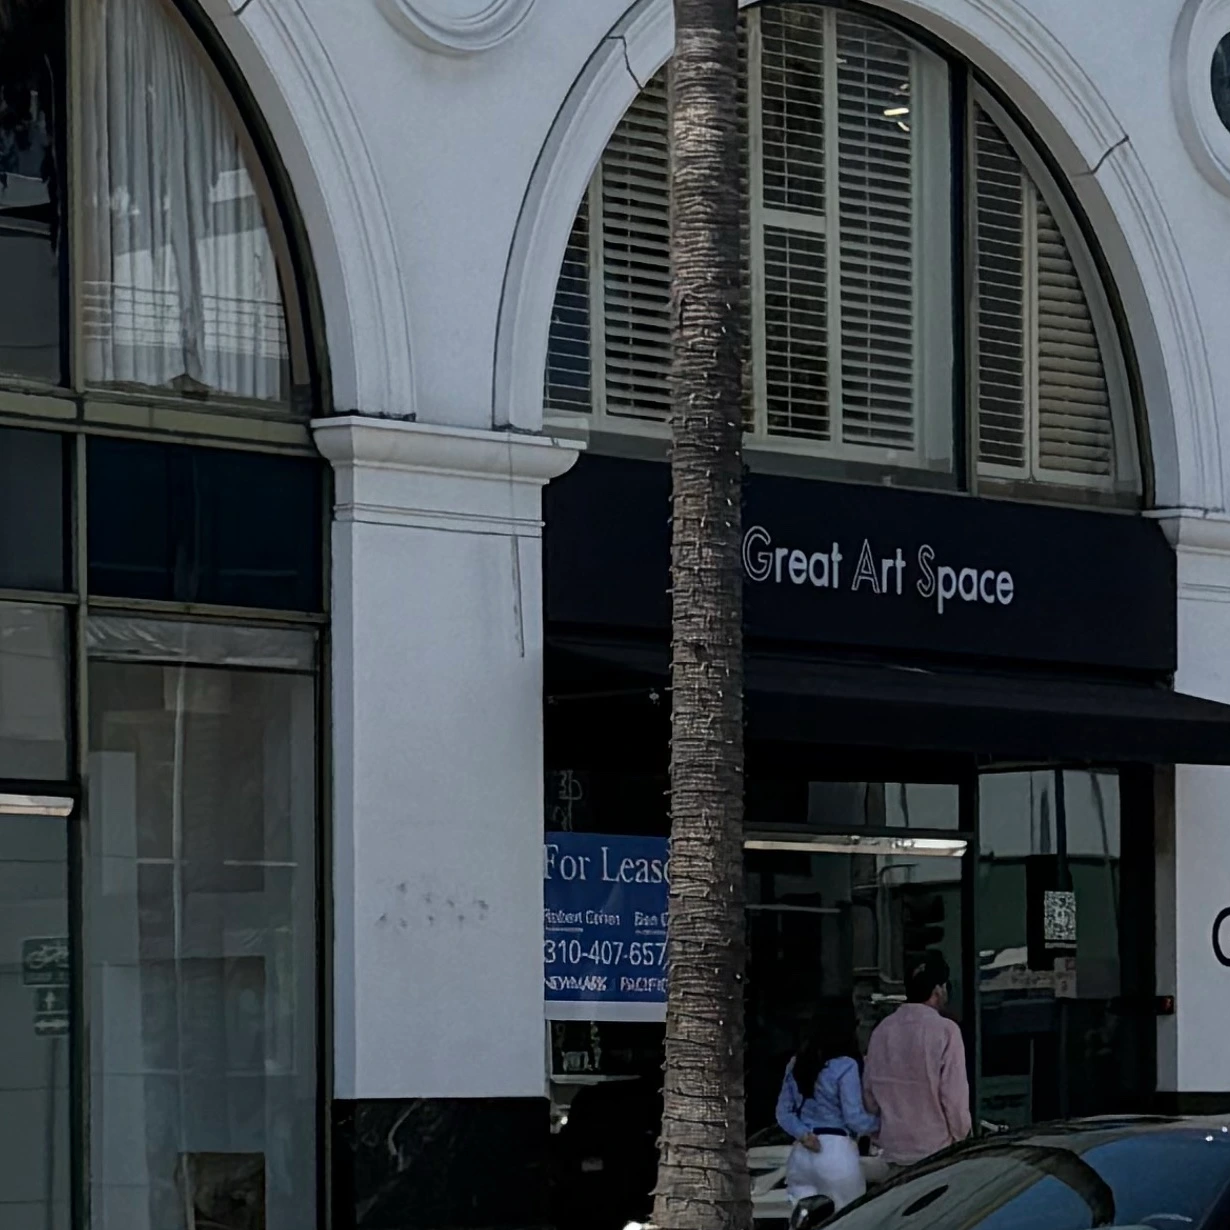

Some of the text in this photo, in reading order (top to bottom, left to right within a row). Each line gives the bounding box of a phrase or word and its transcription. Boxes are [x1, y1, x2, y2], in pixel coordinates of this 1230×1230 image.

[742, 526, 1014, 614] Great Art Space
[544, 844, 591, 881] For
[544, 939, 668, 966] 310-407-657
